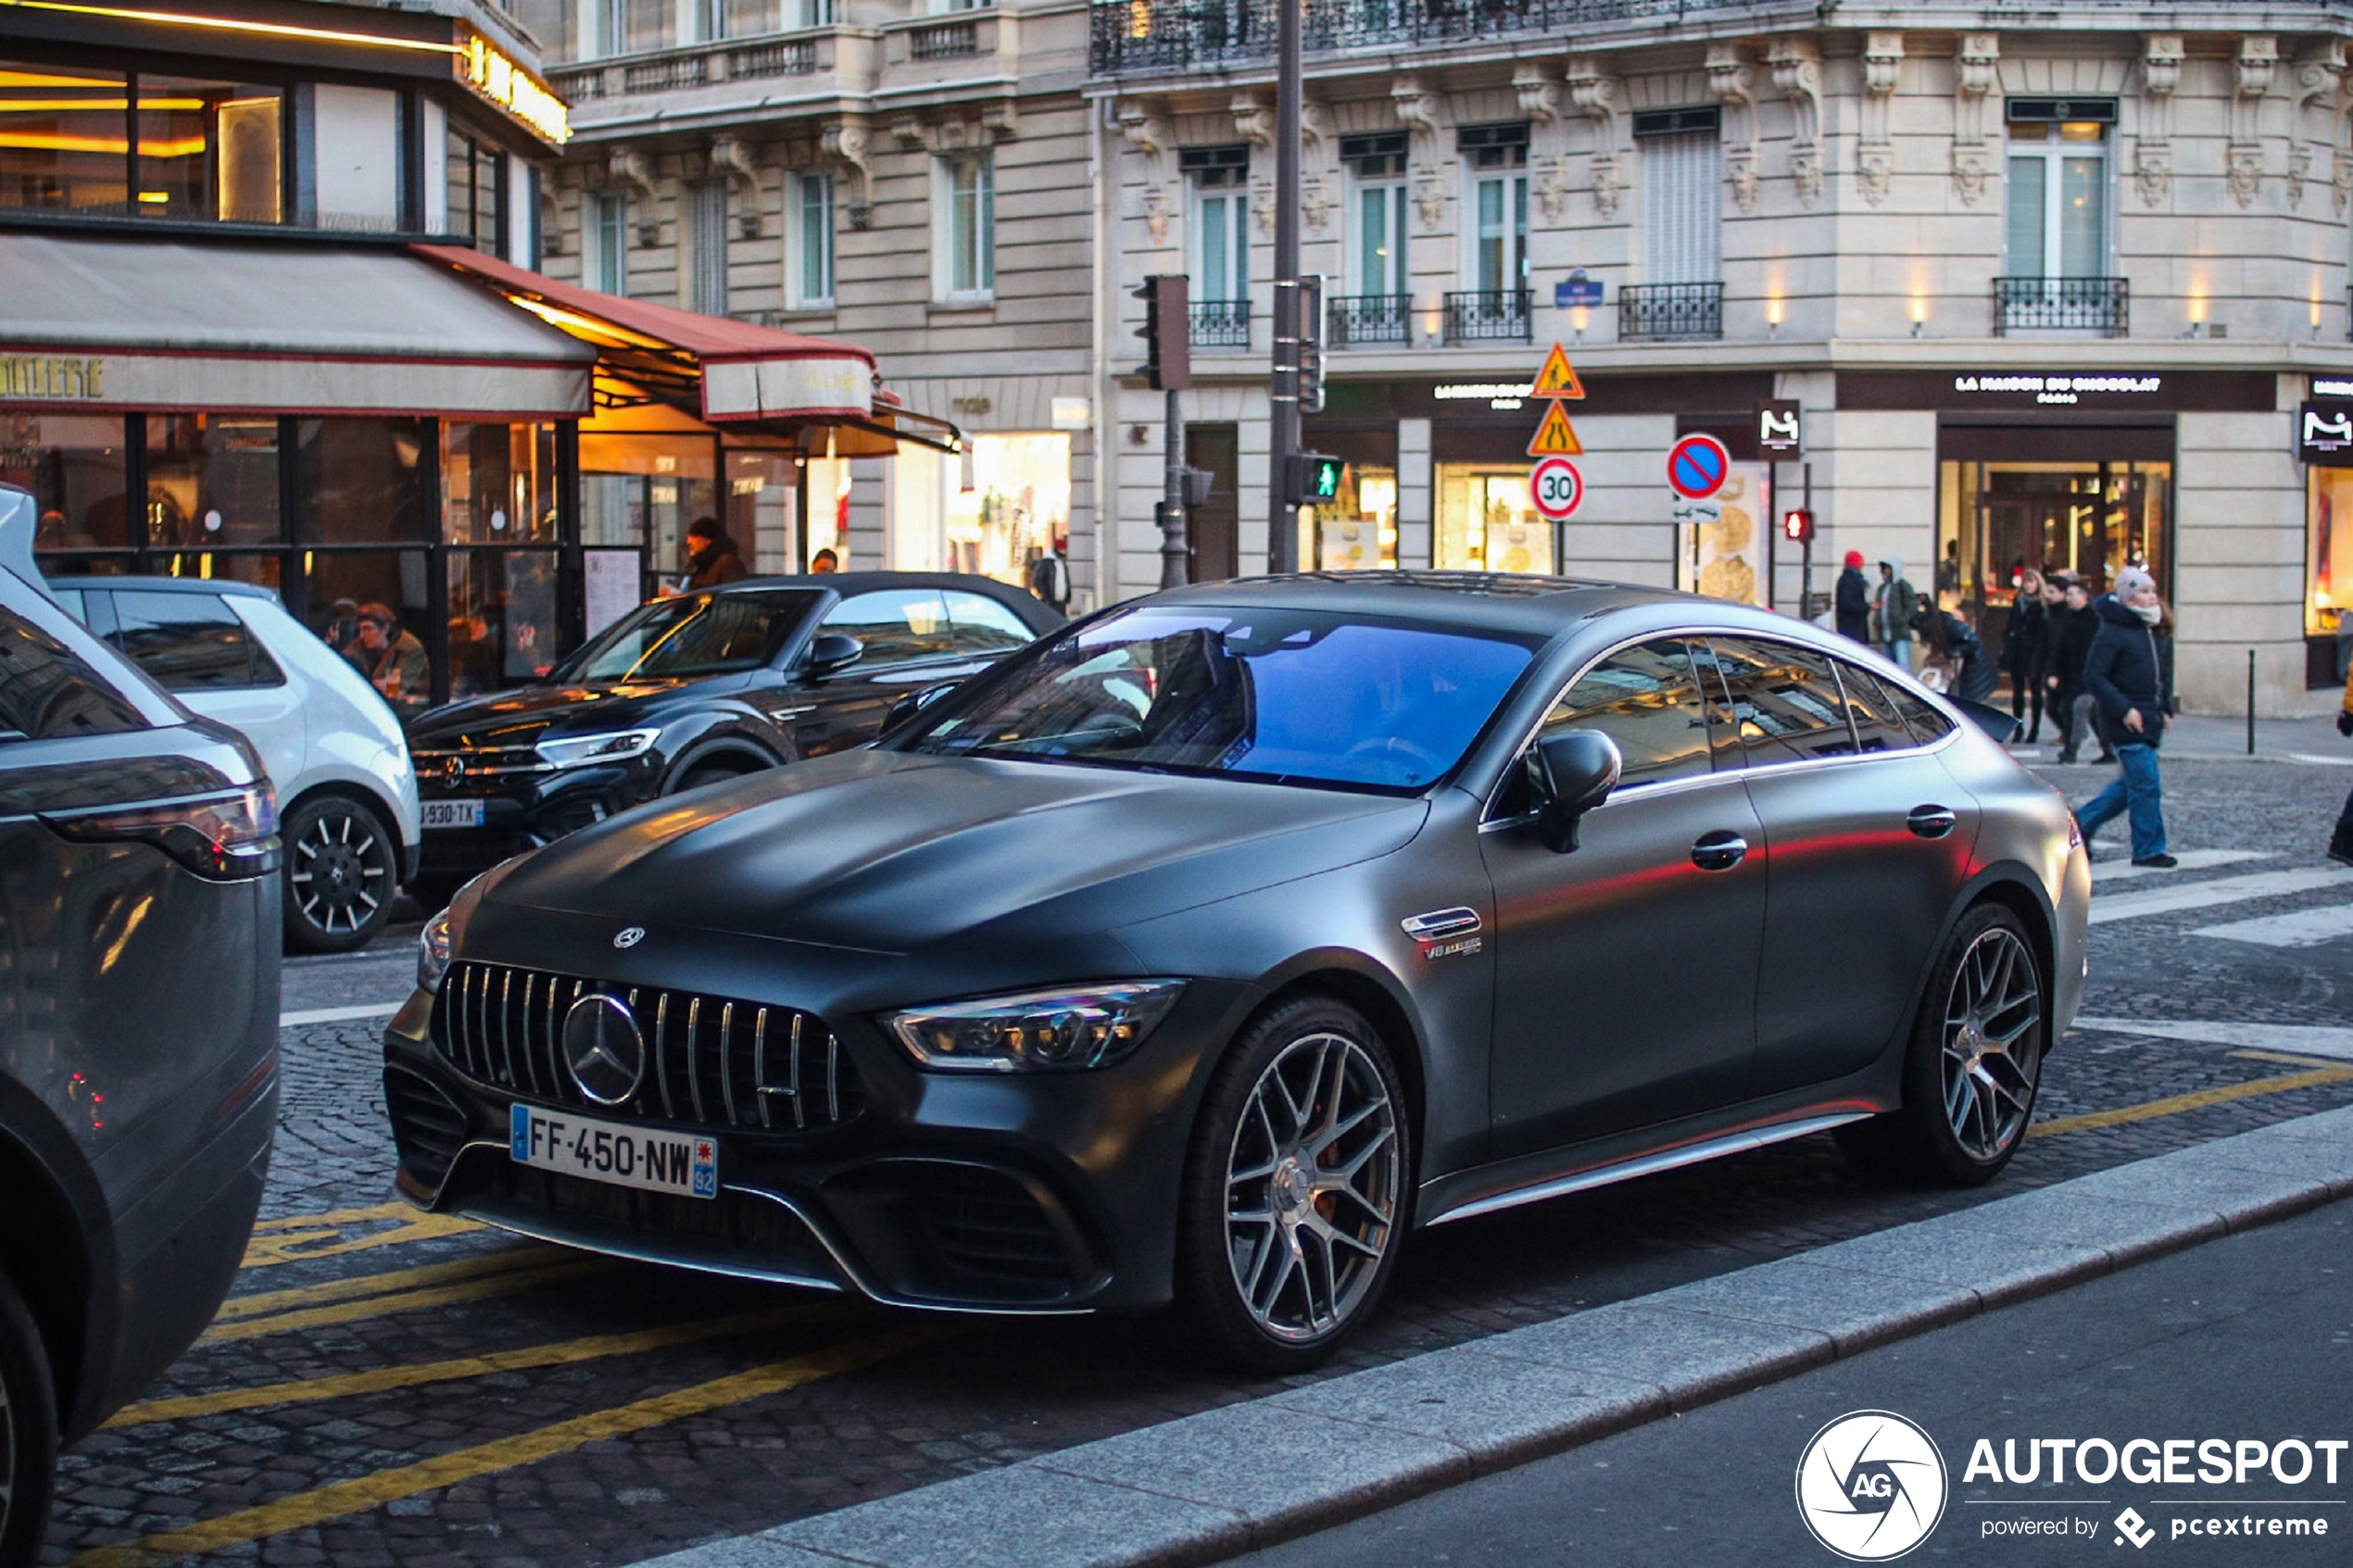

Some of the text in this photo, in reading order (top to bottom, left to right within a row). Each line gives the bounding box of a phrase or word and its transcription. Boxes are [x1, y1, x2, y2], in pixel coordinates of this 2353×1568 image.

[1956, 377, 1979, 391] LA
[1980, 377, 2045, 391] MAISON
[2045, 377, 2071, 391] DU
[1542, 475, 1573, 501] 30
[531, 1116, 690, 1185] FF-450-NW
[694, 1170, 713, 1192] 92
